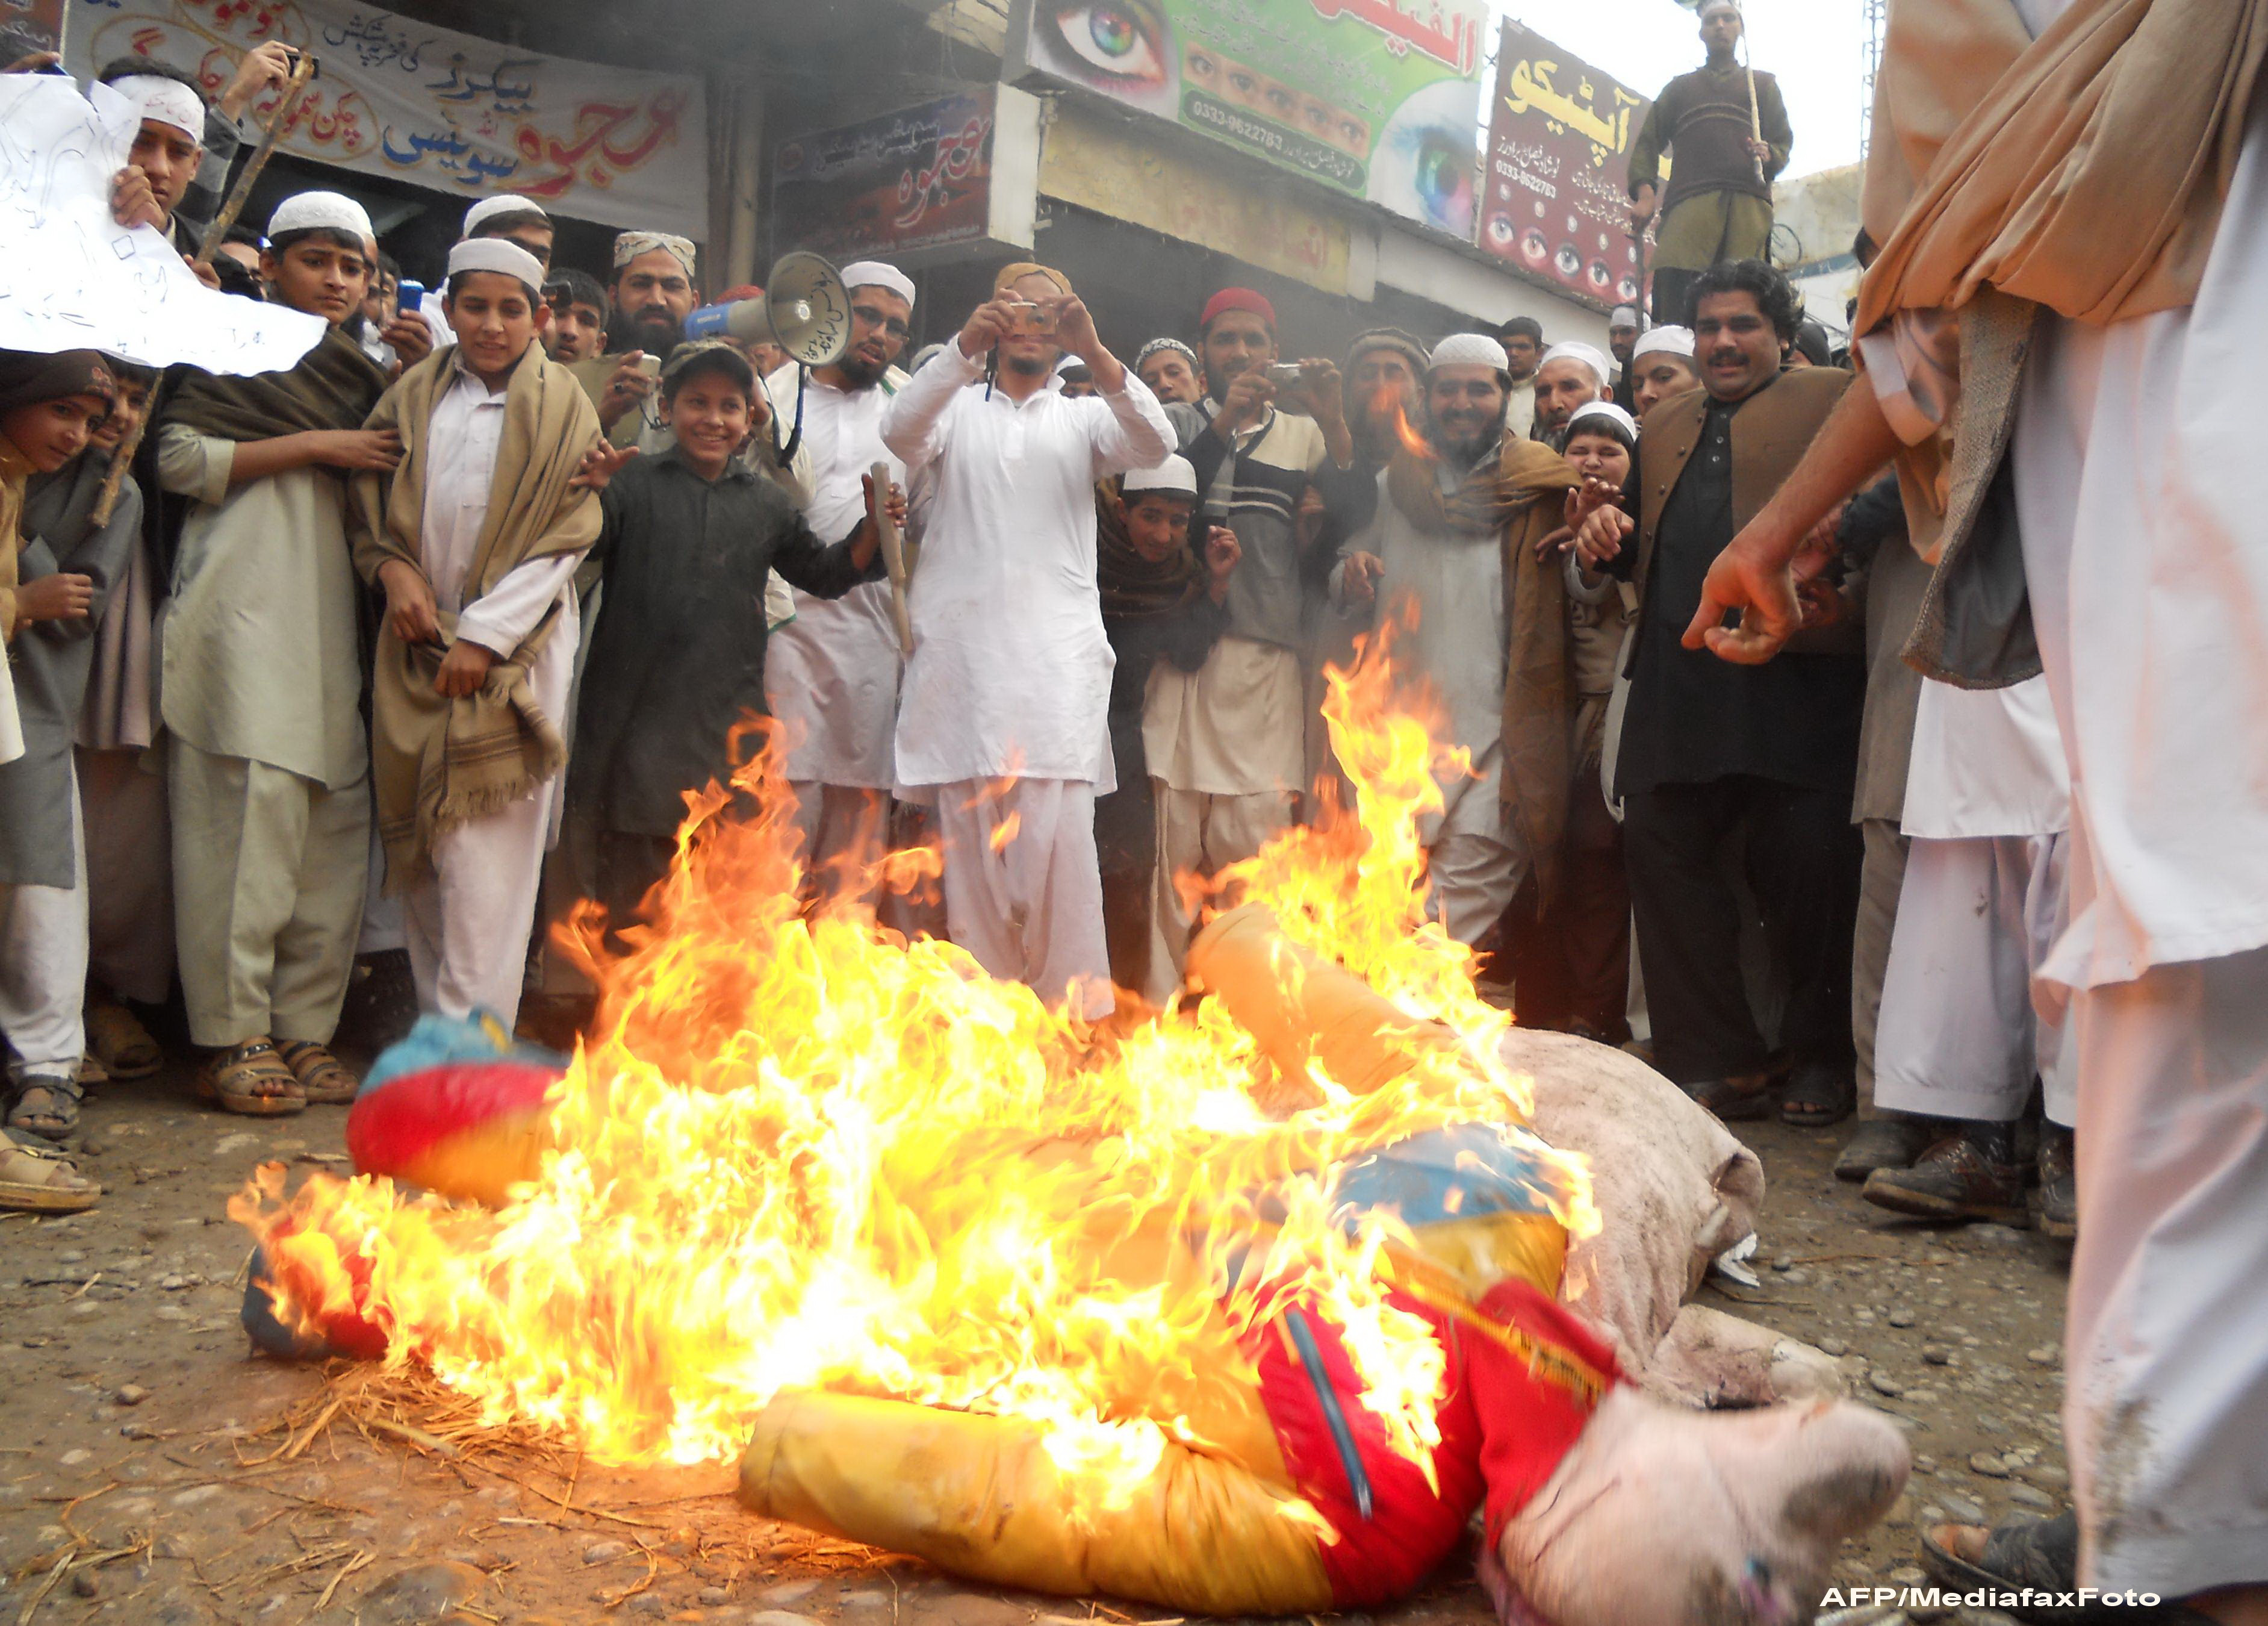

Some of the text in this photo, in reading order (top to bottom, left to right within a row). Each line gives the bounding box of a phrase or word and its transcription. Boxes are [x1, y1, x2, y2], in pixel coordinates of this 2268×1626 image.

[311, 92, 361, 146] چکن
[424, 52, 545, 114] بیکرز
[1505, 60, 1641, 167] آپٹیکو
[509, 86, 688, 196] عجوہ
[894, 117, 992, 228] عجوہ
